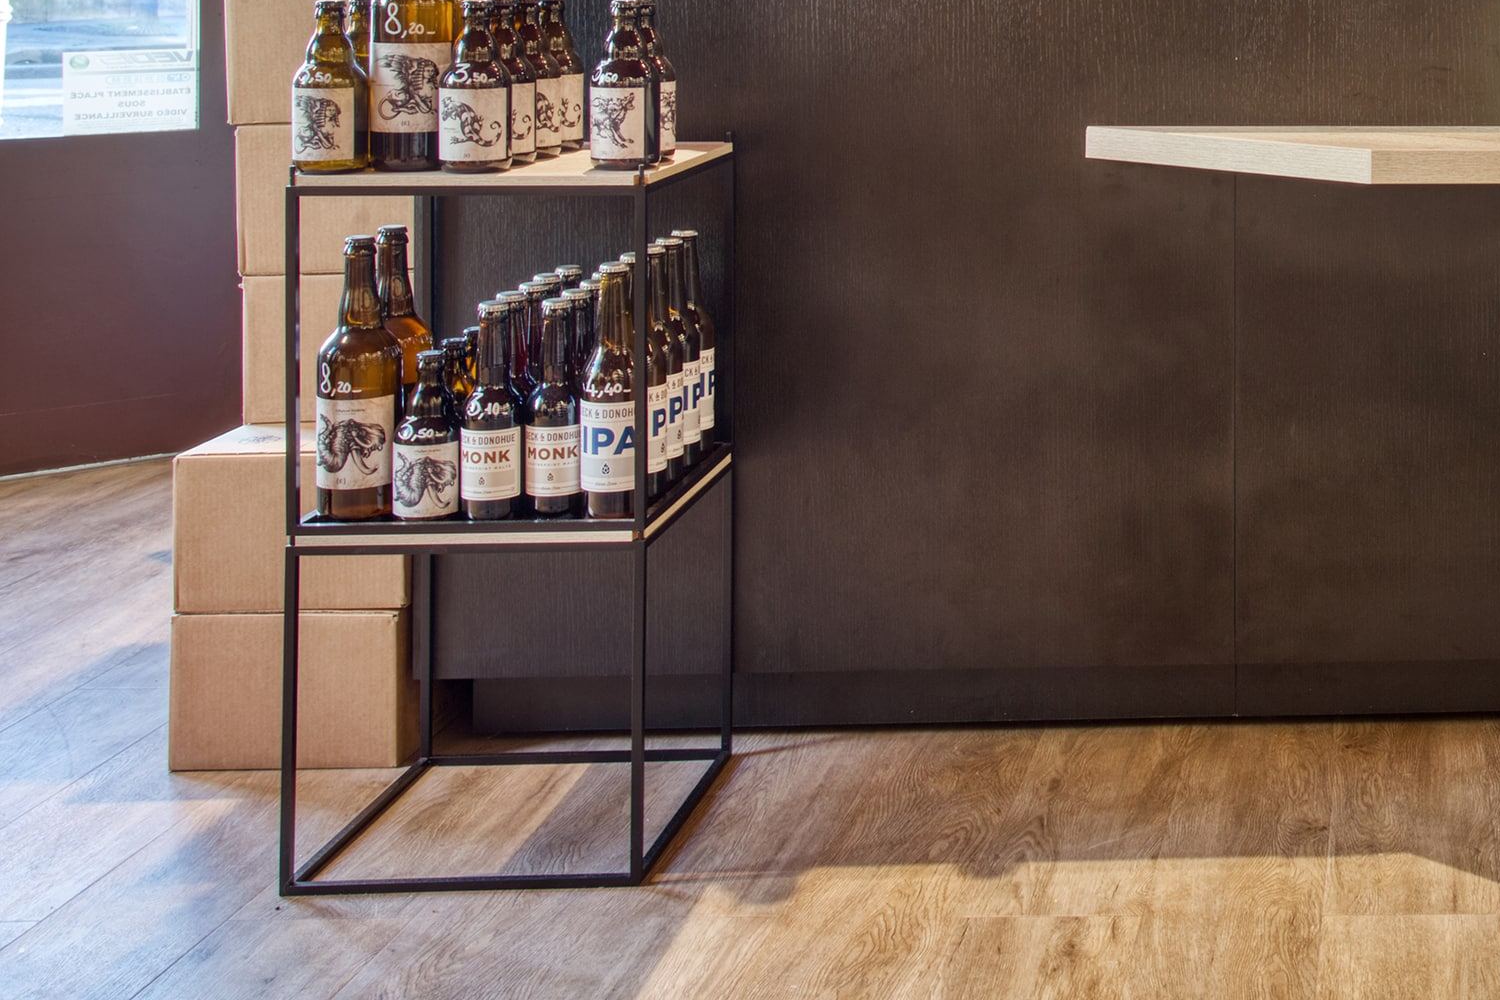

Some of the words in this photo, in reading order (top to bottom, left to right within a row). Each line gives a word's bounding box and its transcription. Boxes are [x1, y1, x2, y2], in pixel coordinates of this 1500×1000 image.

[478, 434, 515, 445] DONOHUE
[583, 426, 635, 456] IPA
[463, 450, 510, 464] MONK
[528, 444, 577, 460] MONK
